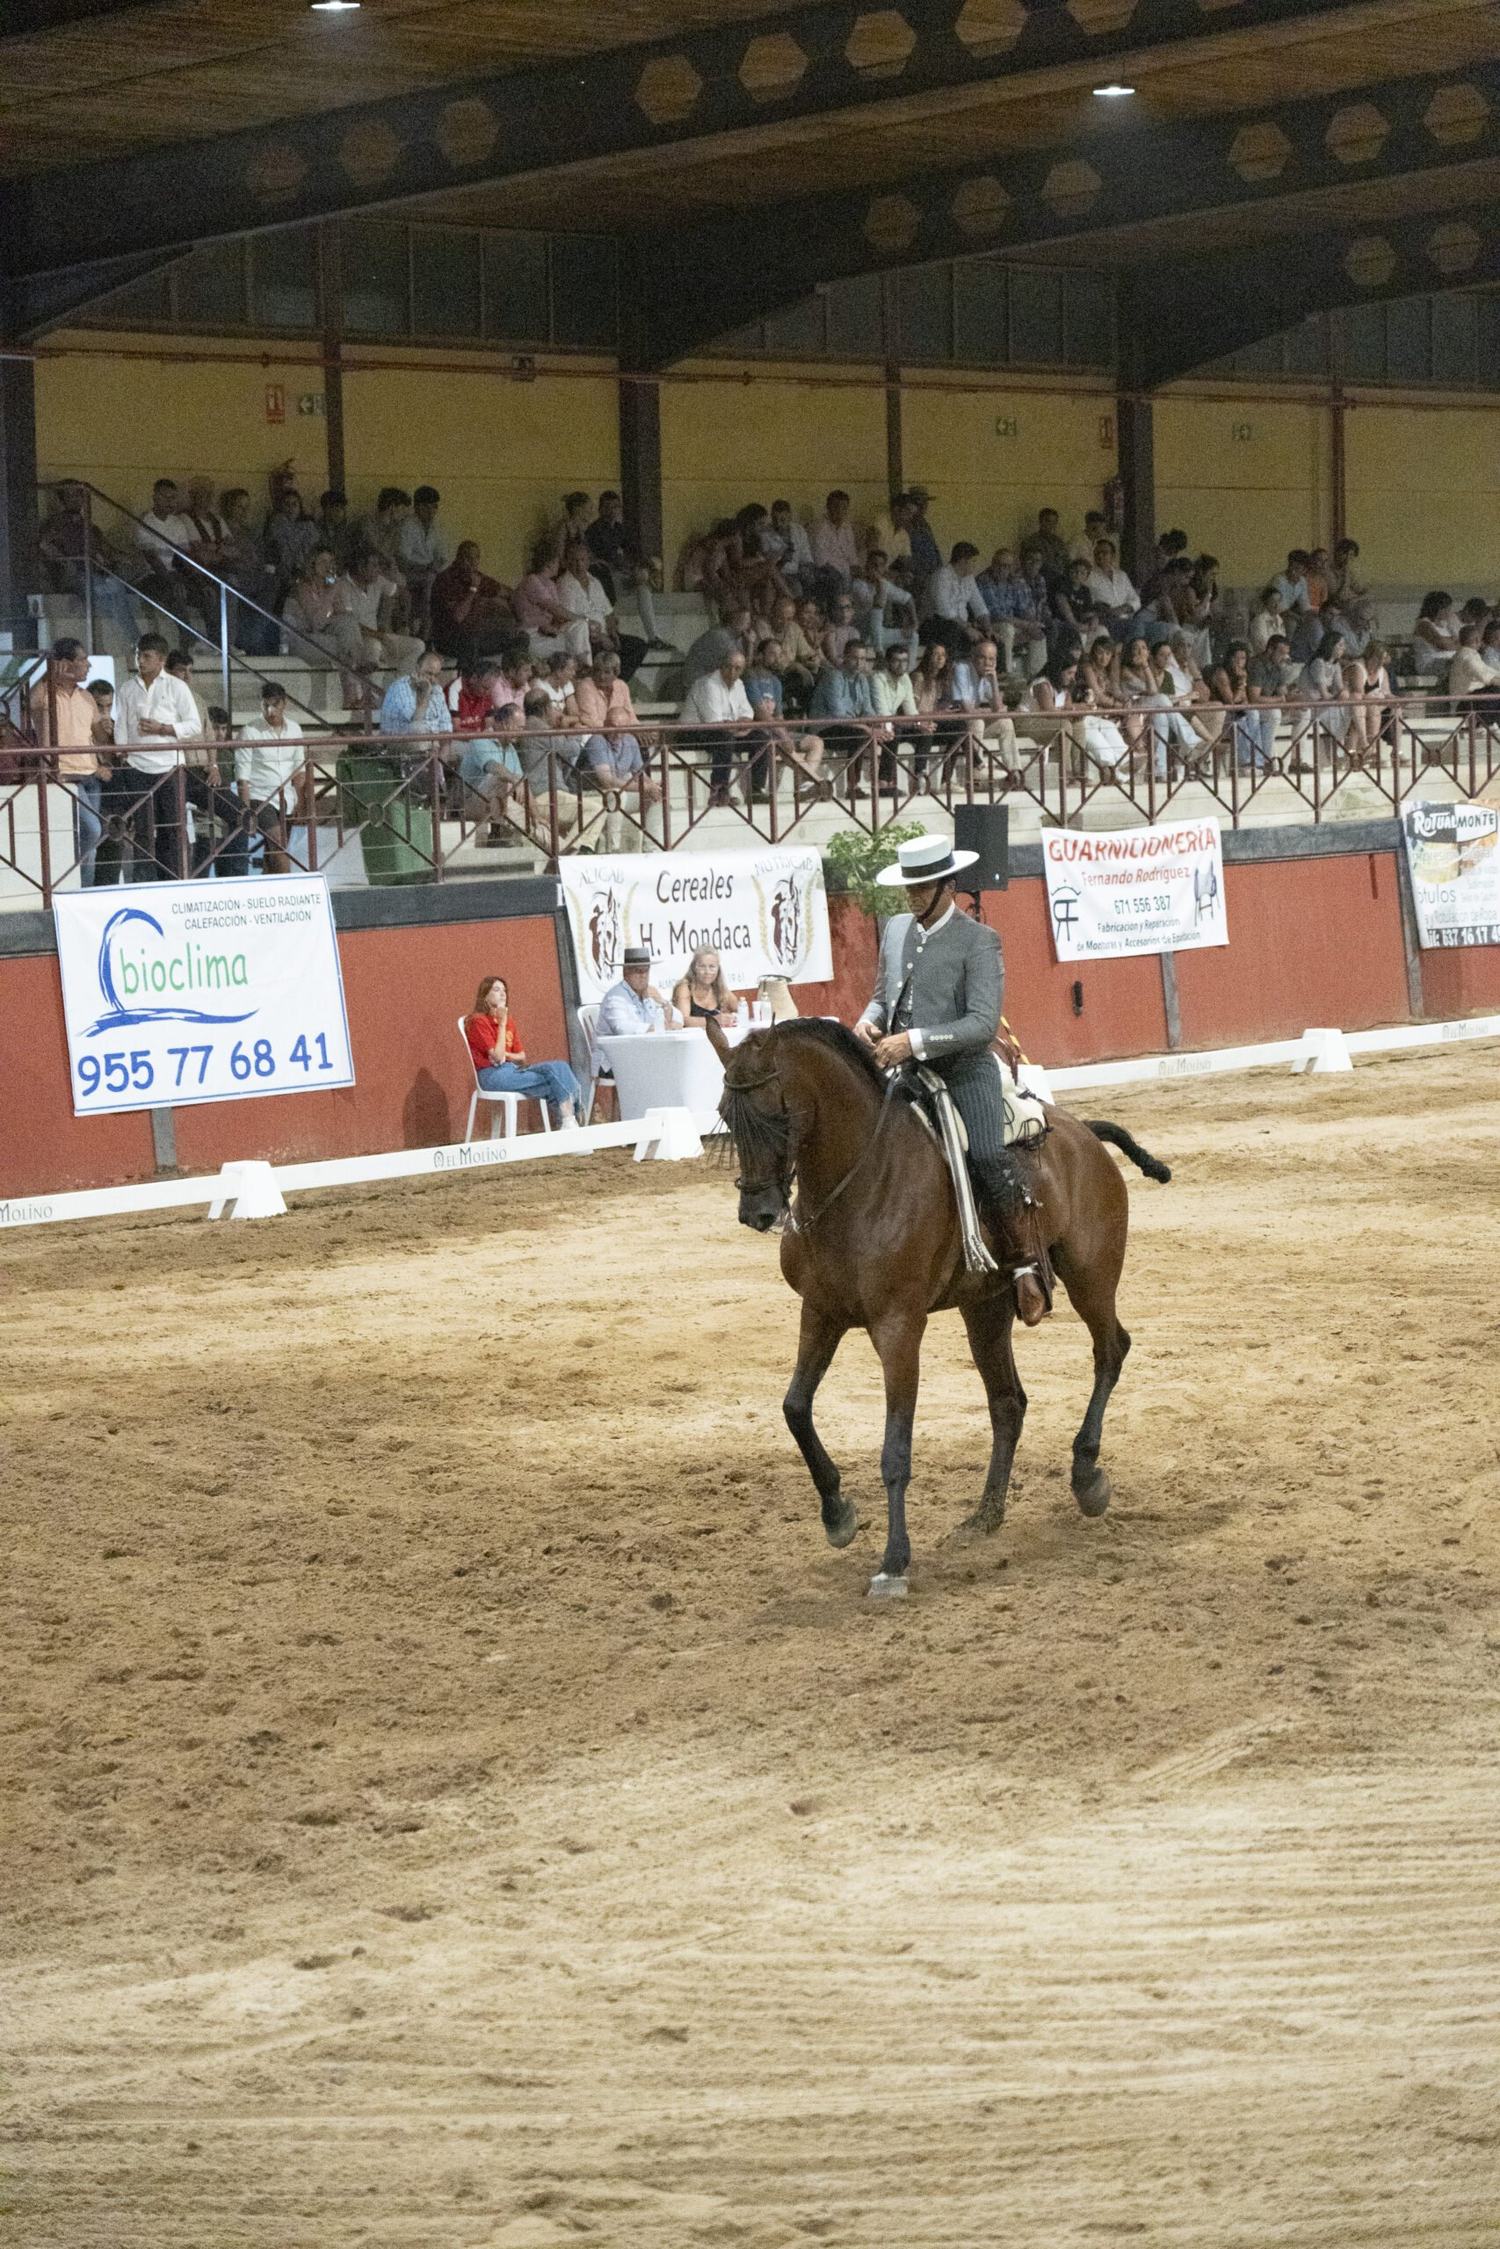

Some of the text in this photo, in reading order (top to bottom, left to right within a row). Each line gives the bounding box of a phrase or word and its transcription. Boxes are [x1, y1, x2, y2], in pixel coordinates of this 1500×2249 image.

[656, 868, 733, 904] Cereales
[1082, 865, 1191, 886] Fernando Rodríguez
[171, 899, 240, 914] CLIMATIZACIÓN
[247, 896, 276, 909] SUELO
[278, 894, 321, 906] RADIANTE
[1114, 900, 1131, 915] 671
[184, 914, 247, 930] CALEFACCIÓN
[254, 909, 312, 925] VENTILACIÓN
[640, 917, 752, 957] H. Mondaca
[120, 942, 248, 994] bioclima
[77, 1032, 333, 1097] 955 77 68 41
